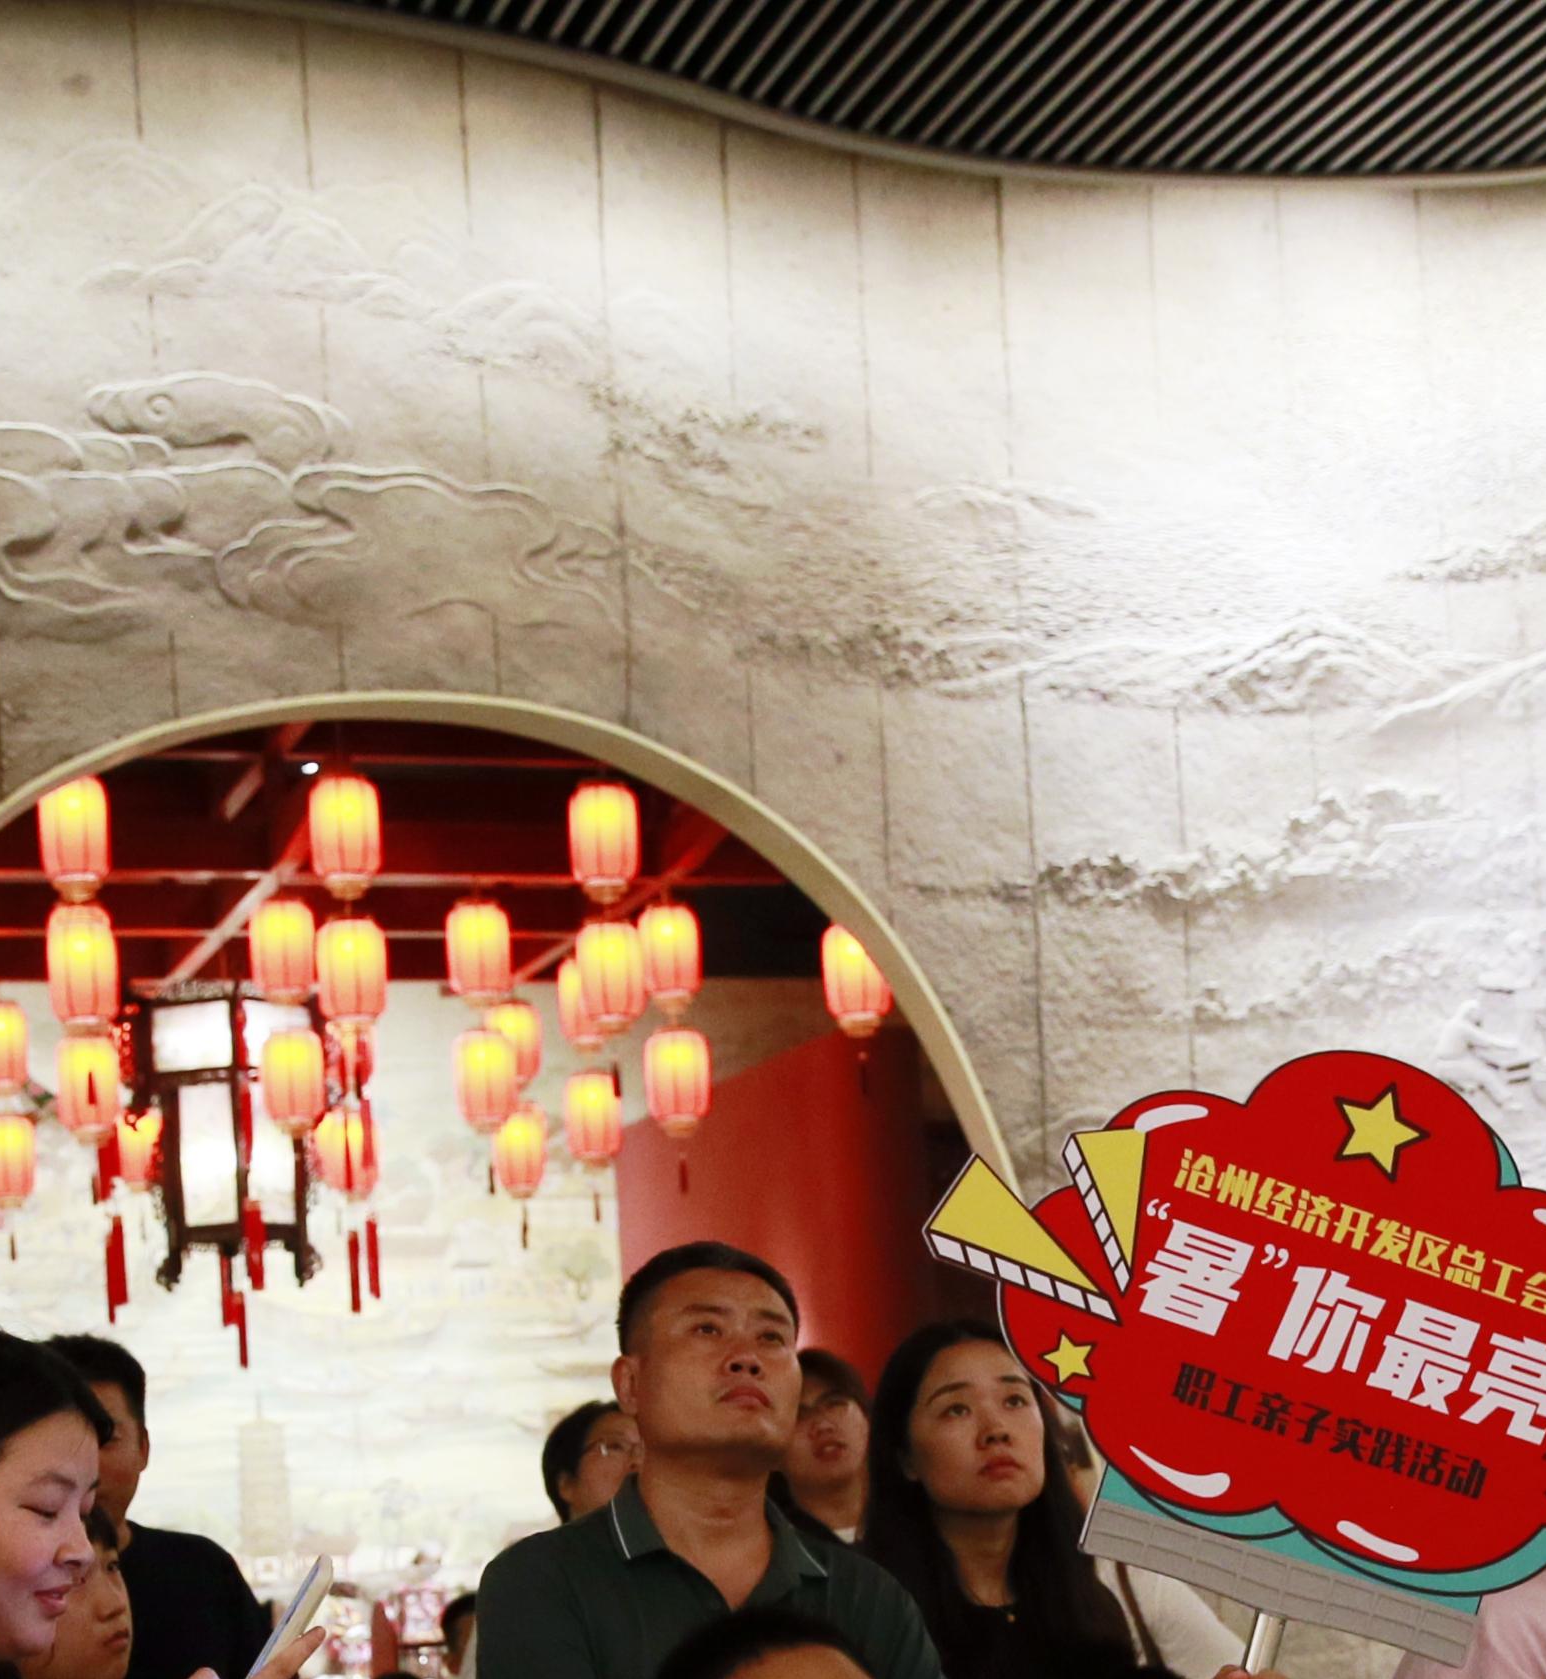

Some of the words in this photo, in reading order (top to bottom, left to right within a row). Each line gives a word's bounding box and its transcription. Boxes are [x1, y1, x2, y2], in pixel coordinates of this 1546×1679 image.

[1171, 1362, 1487, 1501] 职工亲子实践活动
